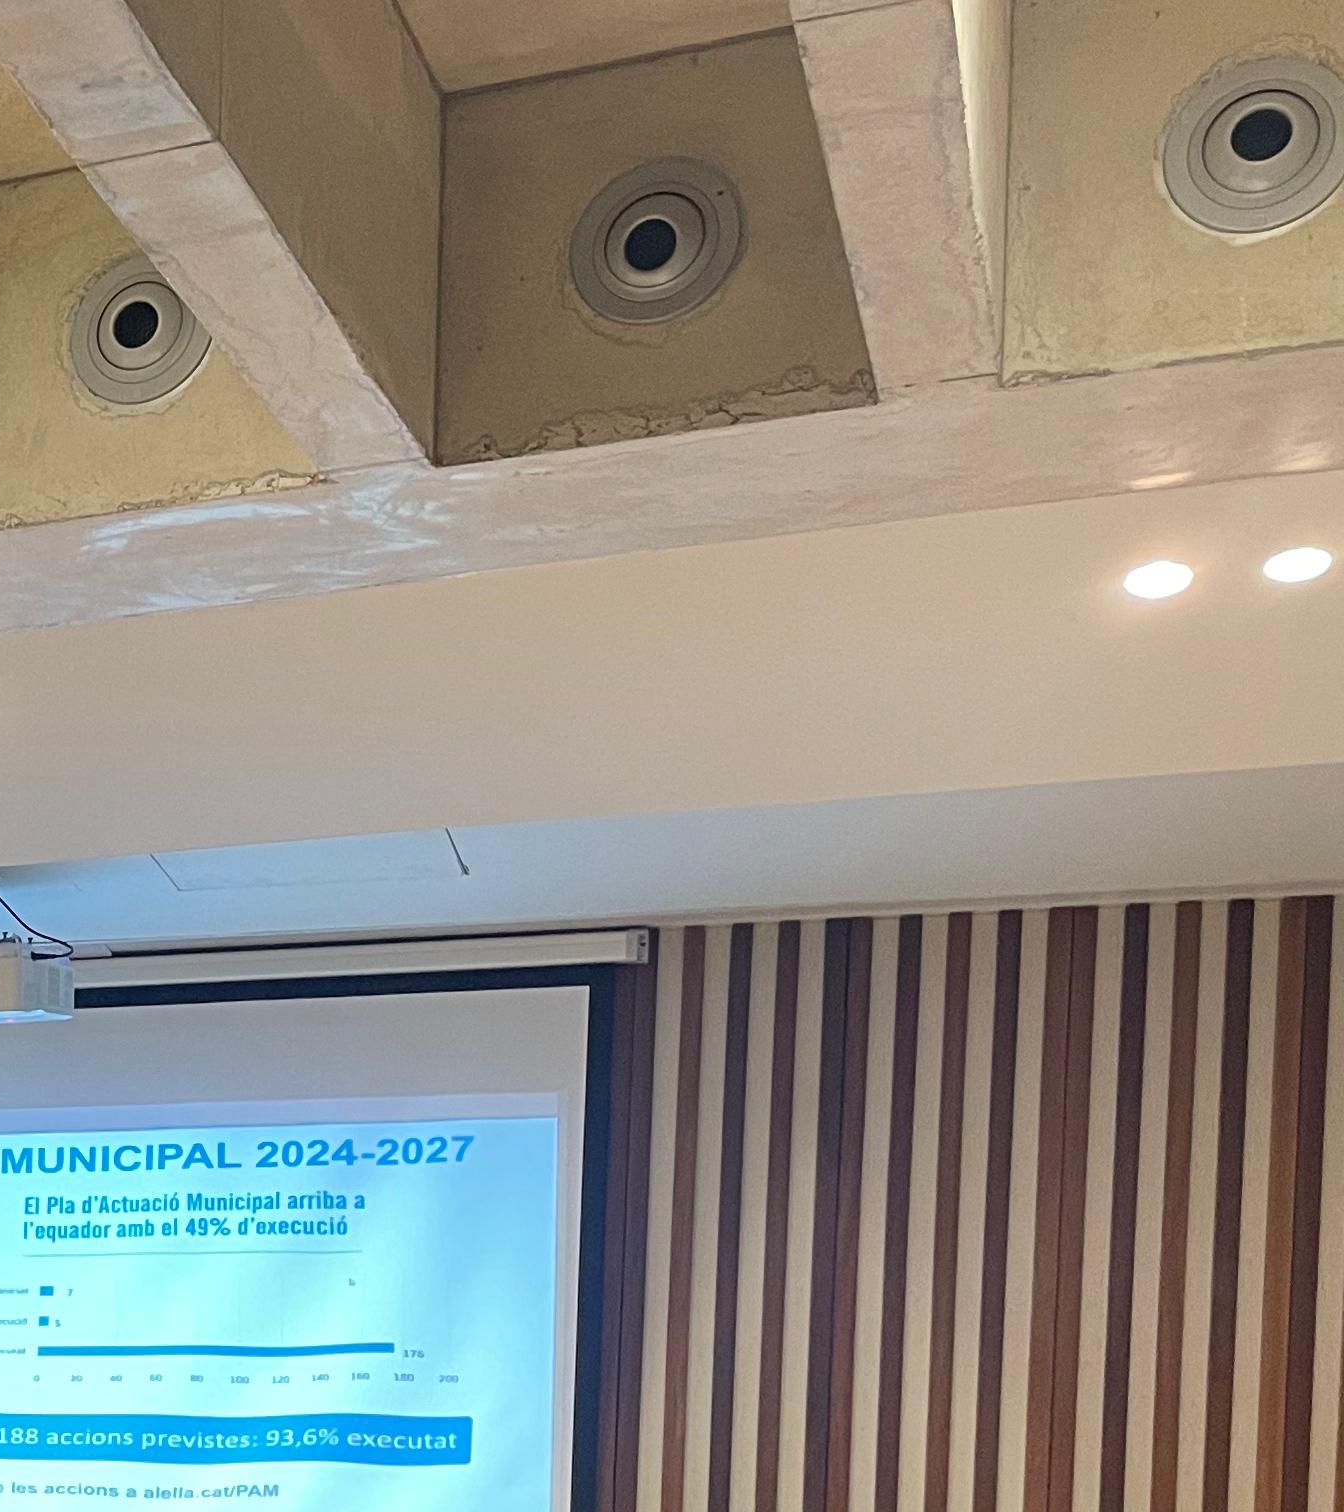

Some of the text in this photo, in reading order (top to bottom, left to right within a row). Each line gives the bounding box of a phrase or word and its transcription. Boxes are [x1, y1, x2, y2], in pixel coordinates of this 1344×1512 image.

[1, 1142, 242, 1174] MUNICIPAL
[256, 1136, 474, 1167] 2024-2027
[25, 1190, 365, 1215] El Pla d'Actuació Municipal arriba a
[24, 1215, 347, 1243] l'equador amb el 49% d'execució
[402, 1349, 425, 1359] 176
[271, 1375, 290, 1385] 120
[351, 1372, 371, 1381] 160
[0, 1428, 38, 1444] 188
[47, 1430, 133, 1444] accions
[142, 1432, 256, 1449] previstes:
[267, 1429, 338, 1446] 93,6%
[347, 1433, 456, 1449] executat
[12, 1482, 37, 1493] les
[44, 1482, 119, 1497] accions
[126, 1488, 137, 1498] a
[144, 1484, 279, 1499] alella.cat/PAM
